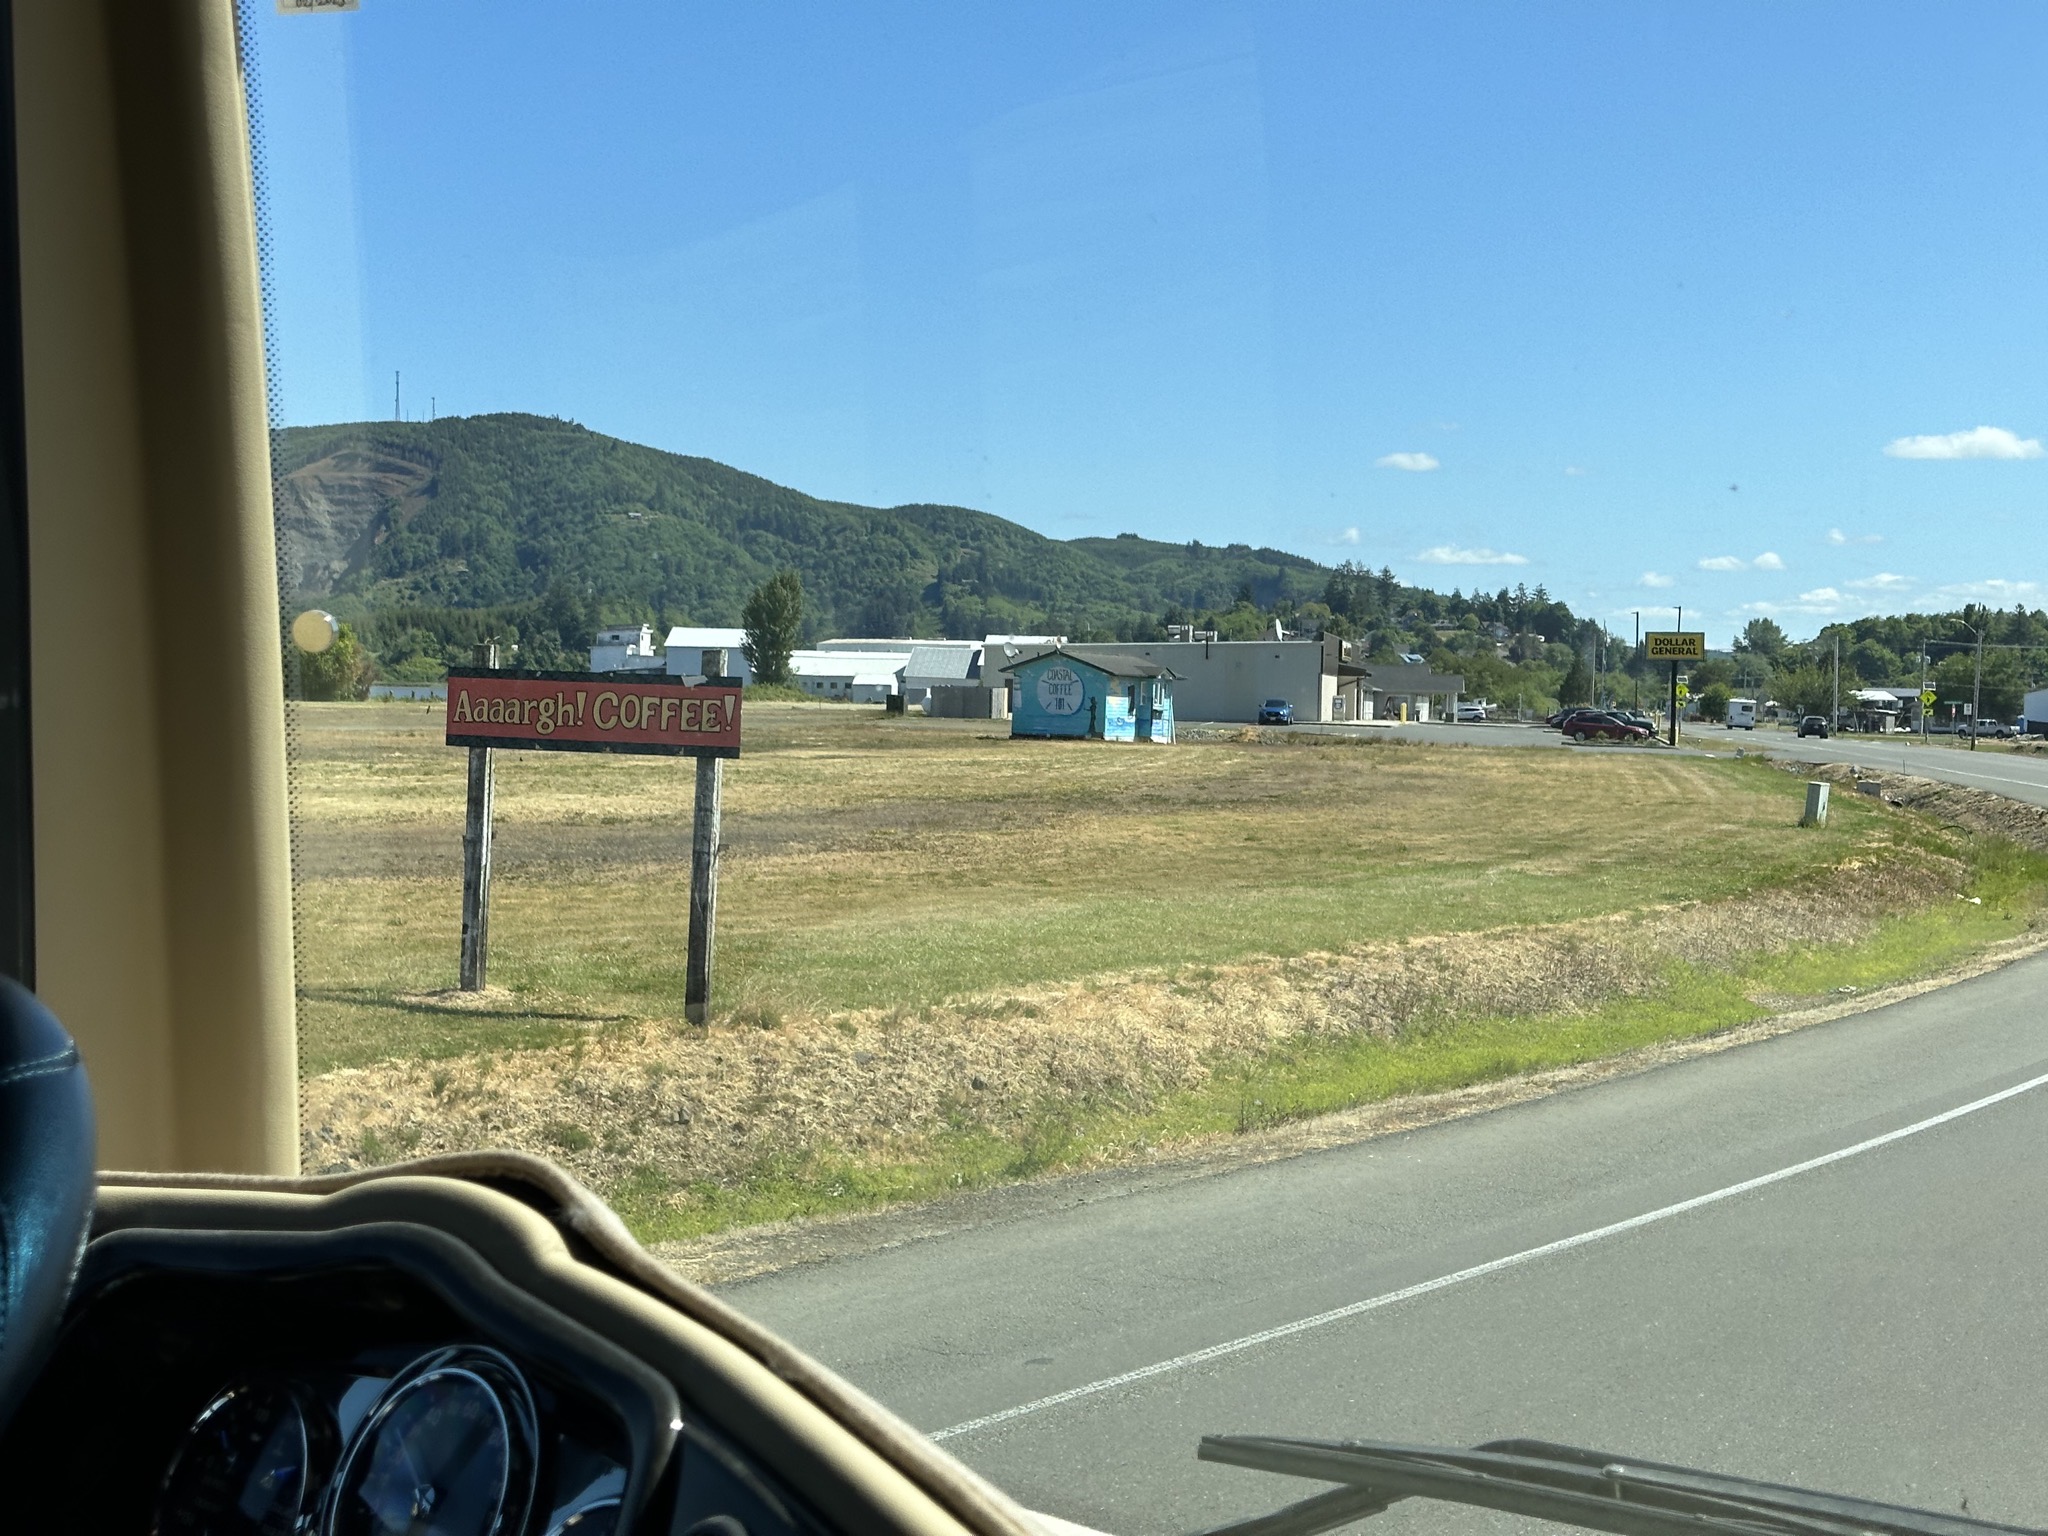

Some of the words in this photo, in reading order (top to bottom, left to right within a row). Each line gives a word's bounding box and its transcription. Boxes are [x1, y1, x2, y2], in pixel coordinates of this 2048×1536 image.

[1654, 638, 1696, 646] DOLLAR
[1651, 646, 1699, 655] GENERAL
[1047, 668, 1073, 681] COASTAL
[1048, 683, 1073, 696] COFFEE
[453, 689, 588, 736] Aaaargh!
[593, 690, 737, 734] COFFEE!
